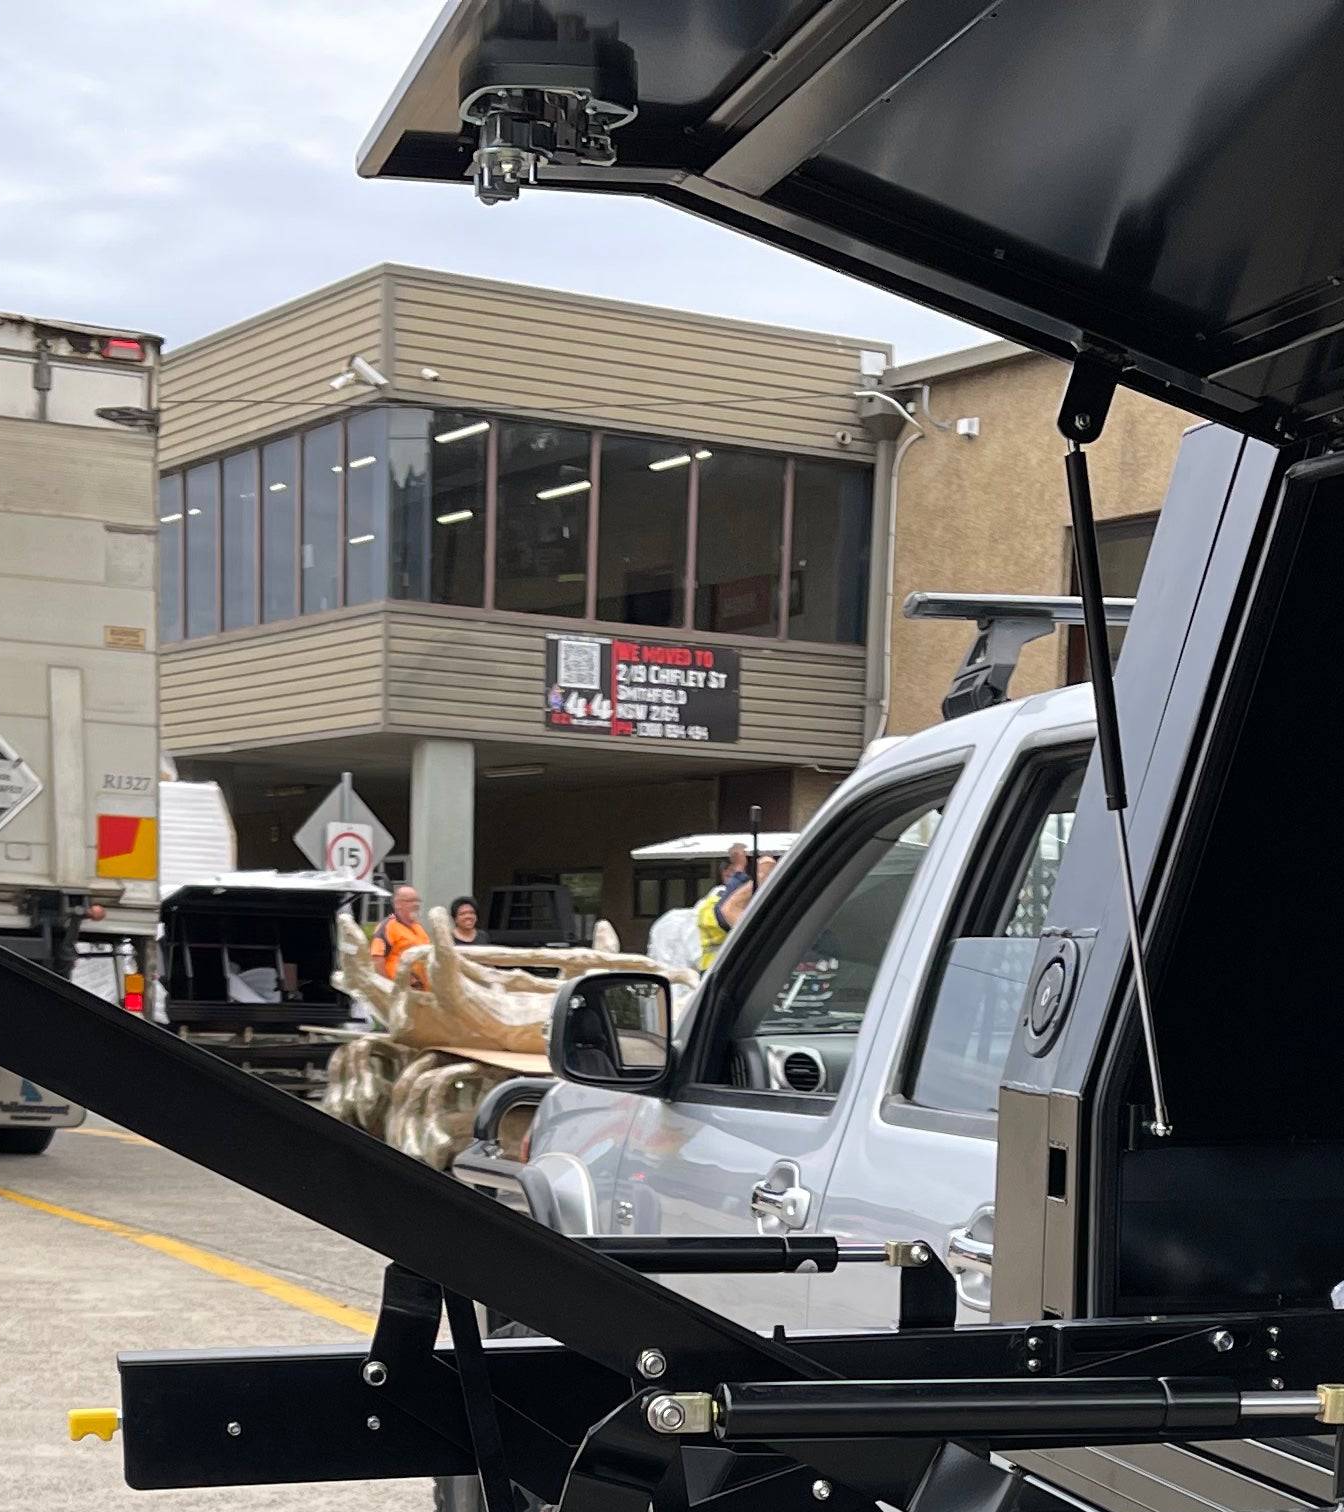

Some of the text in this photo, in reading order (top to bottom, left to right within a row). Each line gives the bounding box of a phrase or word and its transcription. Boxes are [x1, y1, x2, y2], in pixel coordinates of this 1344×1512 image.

[695, 650, 714, 669] TO
[707, 670, 728, 689] ST
[339, 847, 361, 868] 15
